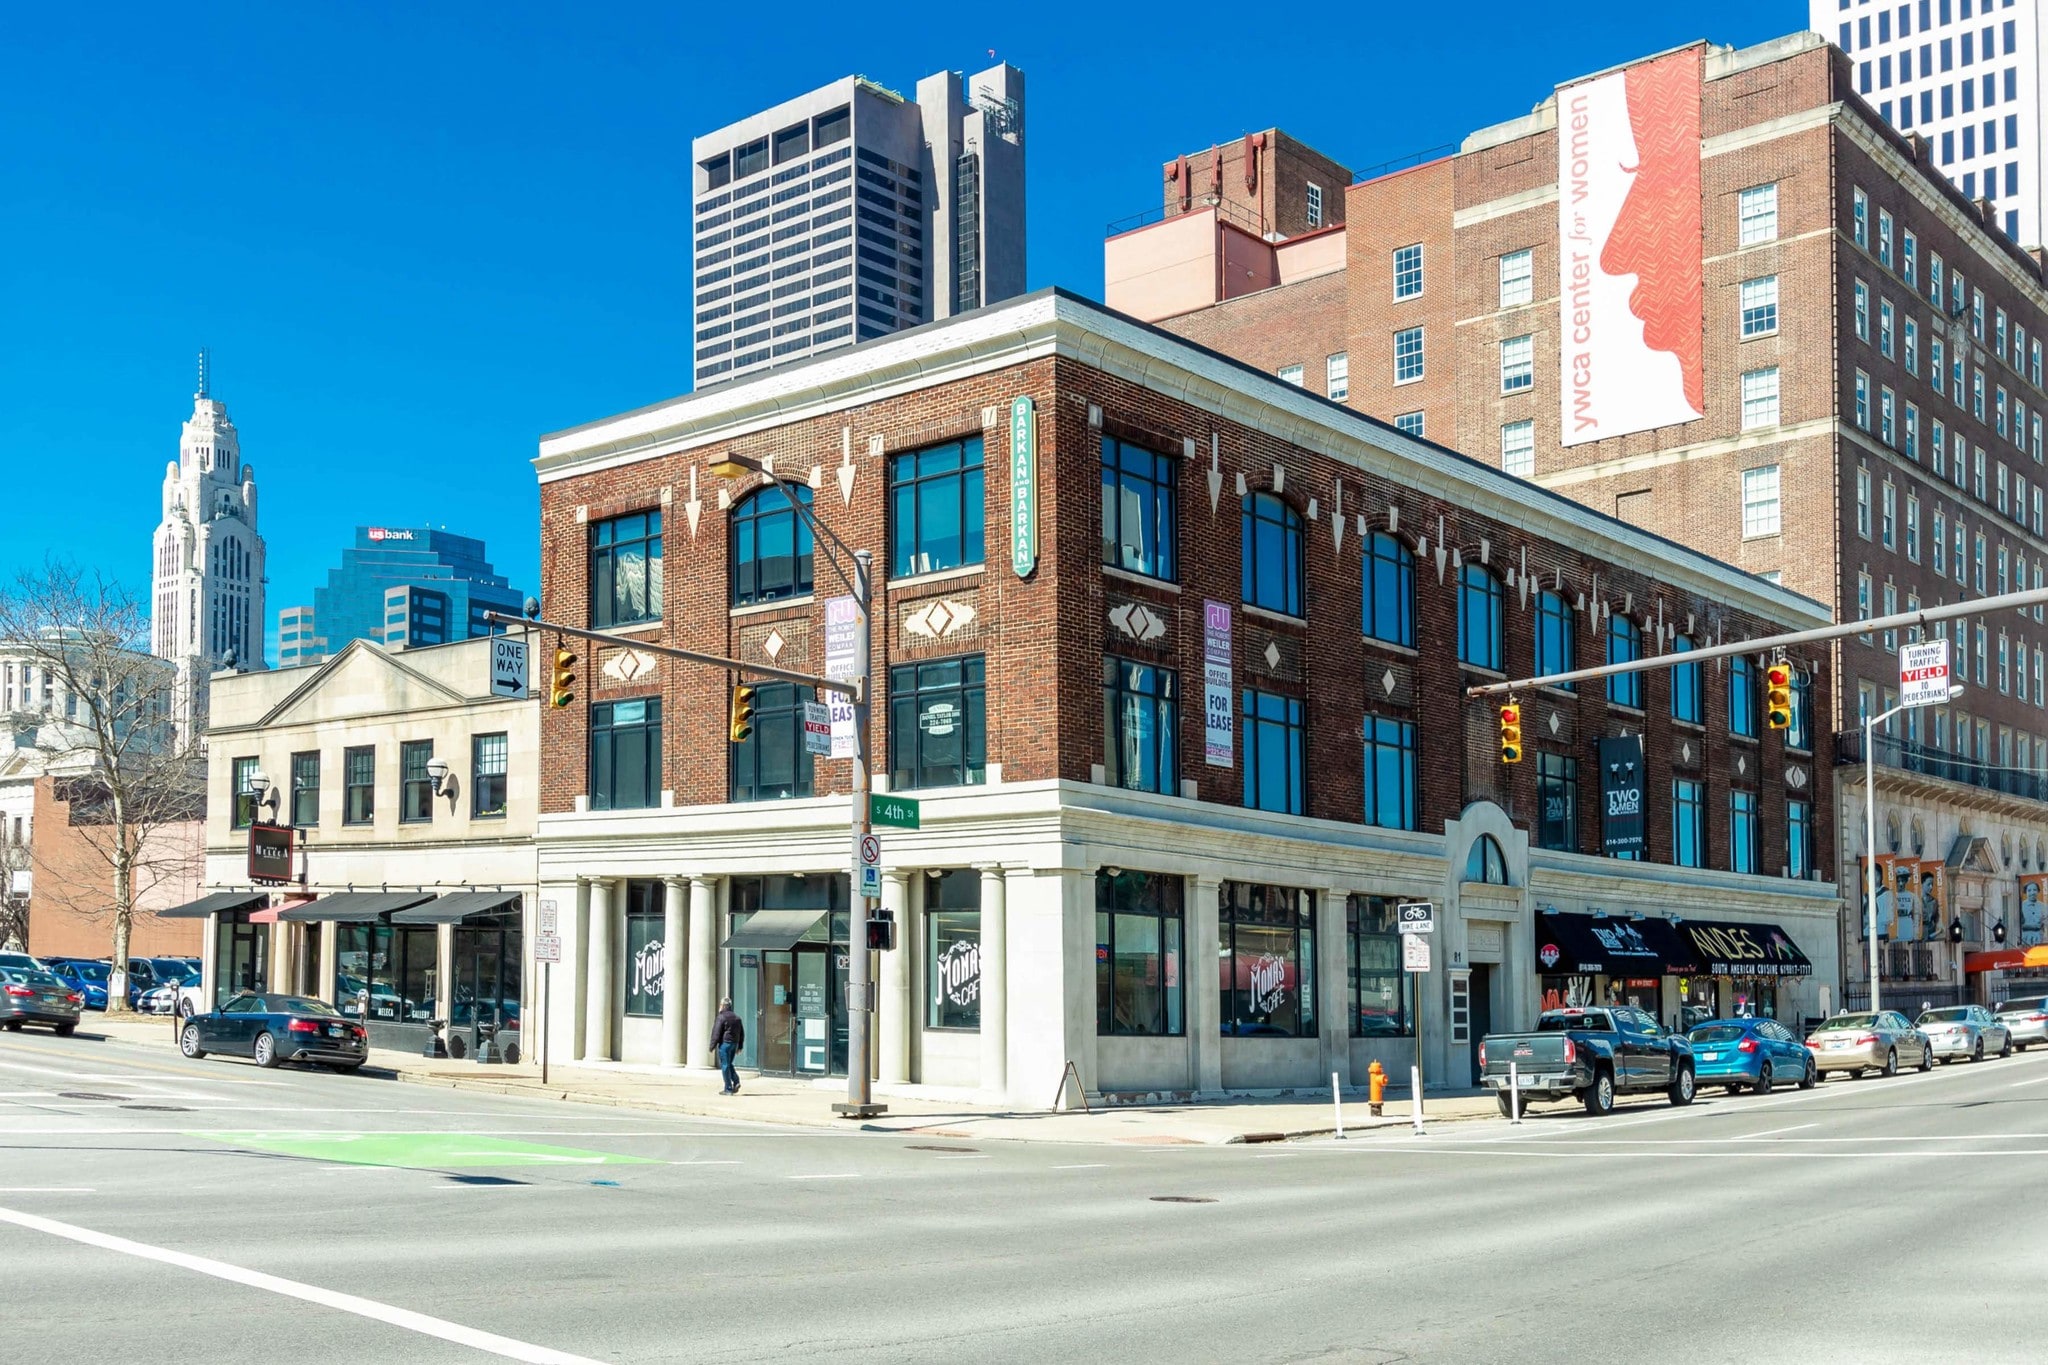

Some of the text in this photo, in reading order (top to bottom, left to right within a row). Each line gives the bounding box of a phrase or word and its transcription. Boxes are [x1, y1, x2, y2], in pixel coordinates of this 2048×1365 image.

[1567, 94, 1598, 433] ywca center for women
[1016, 403, 1028, 478] BARKAN
[1014, 479, 1030, 487] AND
[1017, 487, 1028, 564] BARKAN
[828, 642, 854, 651] COMPAN
[1206, 637, 1230, 650] WEILER
[497, 643, 522, 659] ONE
[1206, 648, 1230, 658] COMPANY
[1908, 646, 1941, 659] TURNING
[496, 658, 524, 675] WAY
[830, 663, 854, 673] OFFICE
[1909, 656, 1940, 668] TRAFFIC
[1209, 670, 1228, 680] OFFICE
[1905, 667, 1944, 681] YIELD
[1206, 677, 1231, 689] BUILDING
[1921, 681, 1929, 690] TO
[1904, 688, 1946, 702] PEDESTRIANS
[1210, 694, 1227, 712] FOR
[808, 705, 826, 715] TURNING
[830, 706, 853, 722] EAS
[809, 713, 826, 722] TRAFFIC
[1206, 713, 1231, 731] LEASE
[807, 722, 829, 734] YIELD
[807, 741, 830, 750] PEDESTRIANS
[1606, 789, 1640, 803] TWO
[876, 804, 914, 820] S 4th St
[1689, 927, 1765, 960] ANDES
[1711, 963, 1728, 974] SOUTH
[1730, 963, 1755, 975] AMERICAN
[1757, 963, 1778, 975] CUISINE
[961, 979, 981, 1006] CAF
[411, 1010, 430, 1019] GALLERY
